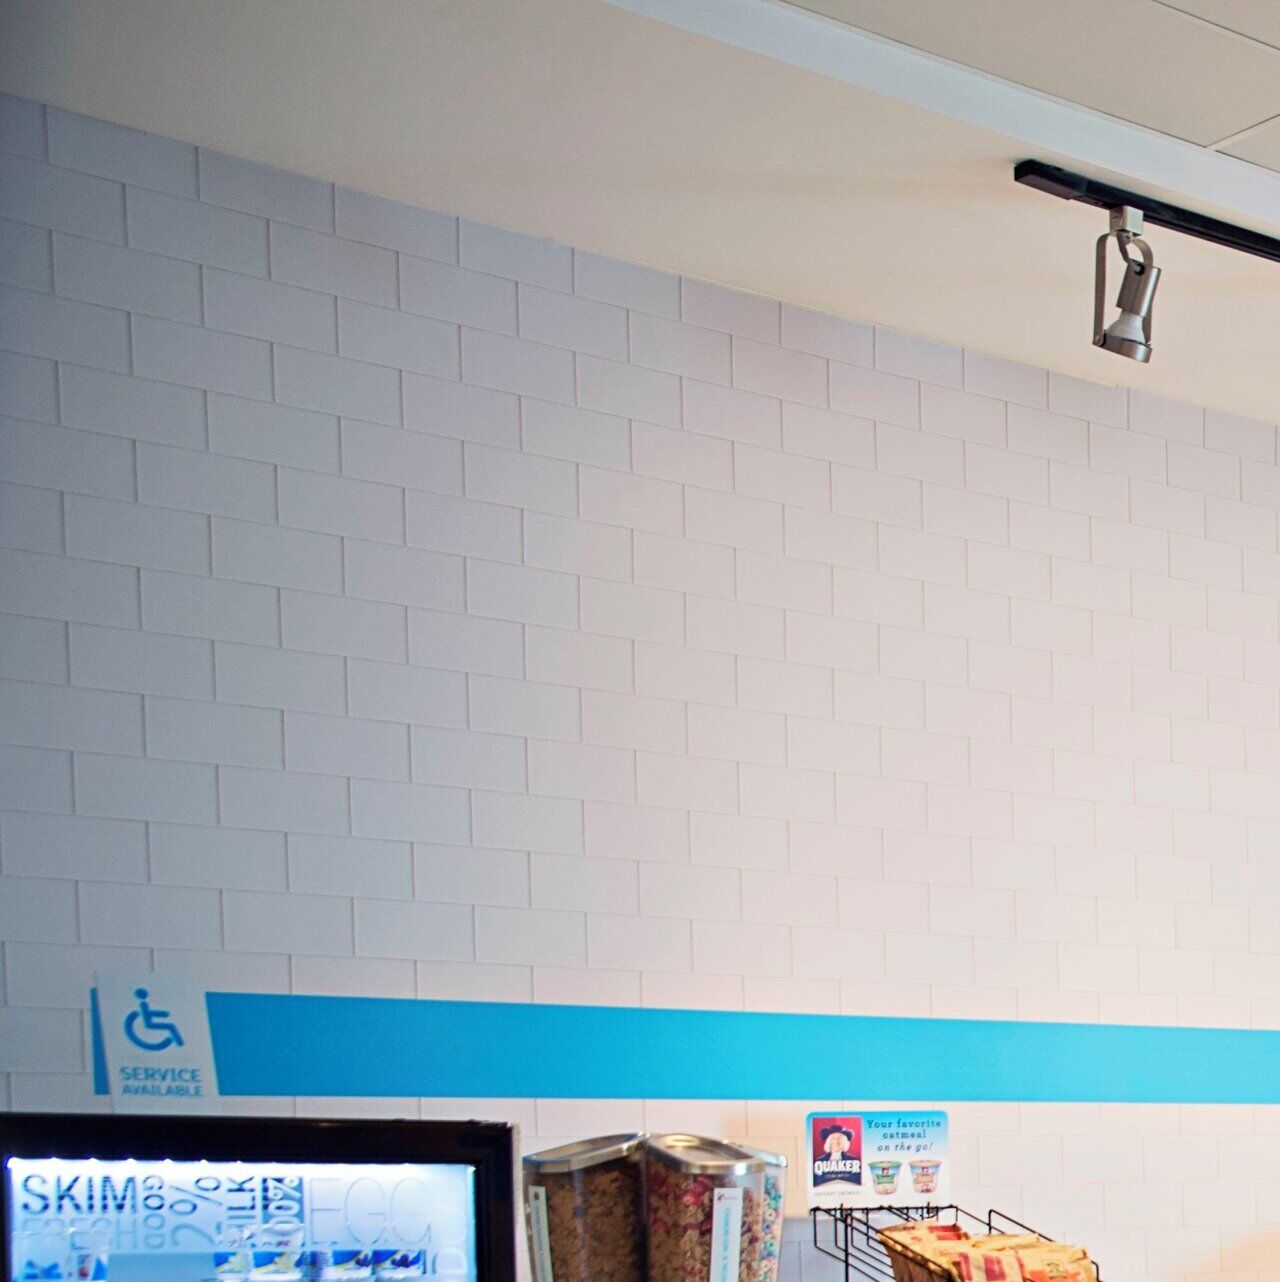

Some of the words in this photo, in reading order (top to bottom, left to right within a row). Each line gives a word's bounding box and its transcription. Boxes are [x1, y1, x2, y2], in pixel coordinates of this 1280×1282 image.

[119, 1066, 202, 1082] SERVICE
[121, 1084, 203, 1097] AVAILABLE
[866, 1118, 893, 1129] Your
[896, 1117, 942, 1129] favorite
[882, 1130, 927, 1140] oatmeal
[877, 1144, 890, 1152] on
[894, 1142, 912, 1152] the
[915, 1142, 934, 1153] go!
[814, 1160, 862, 1176] QUAKER
[21, 1174, 139, 1215] SKIM
[141, 1174, 167, 1250] GOOD
